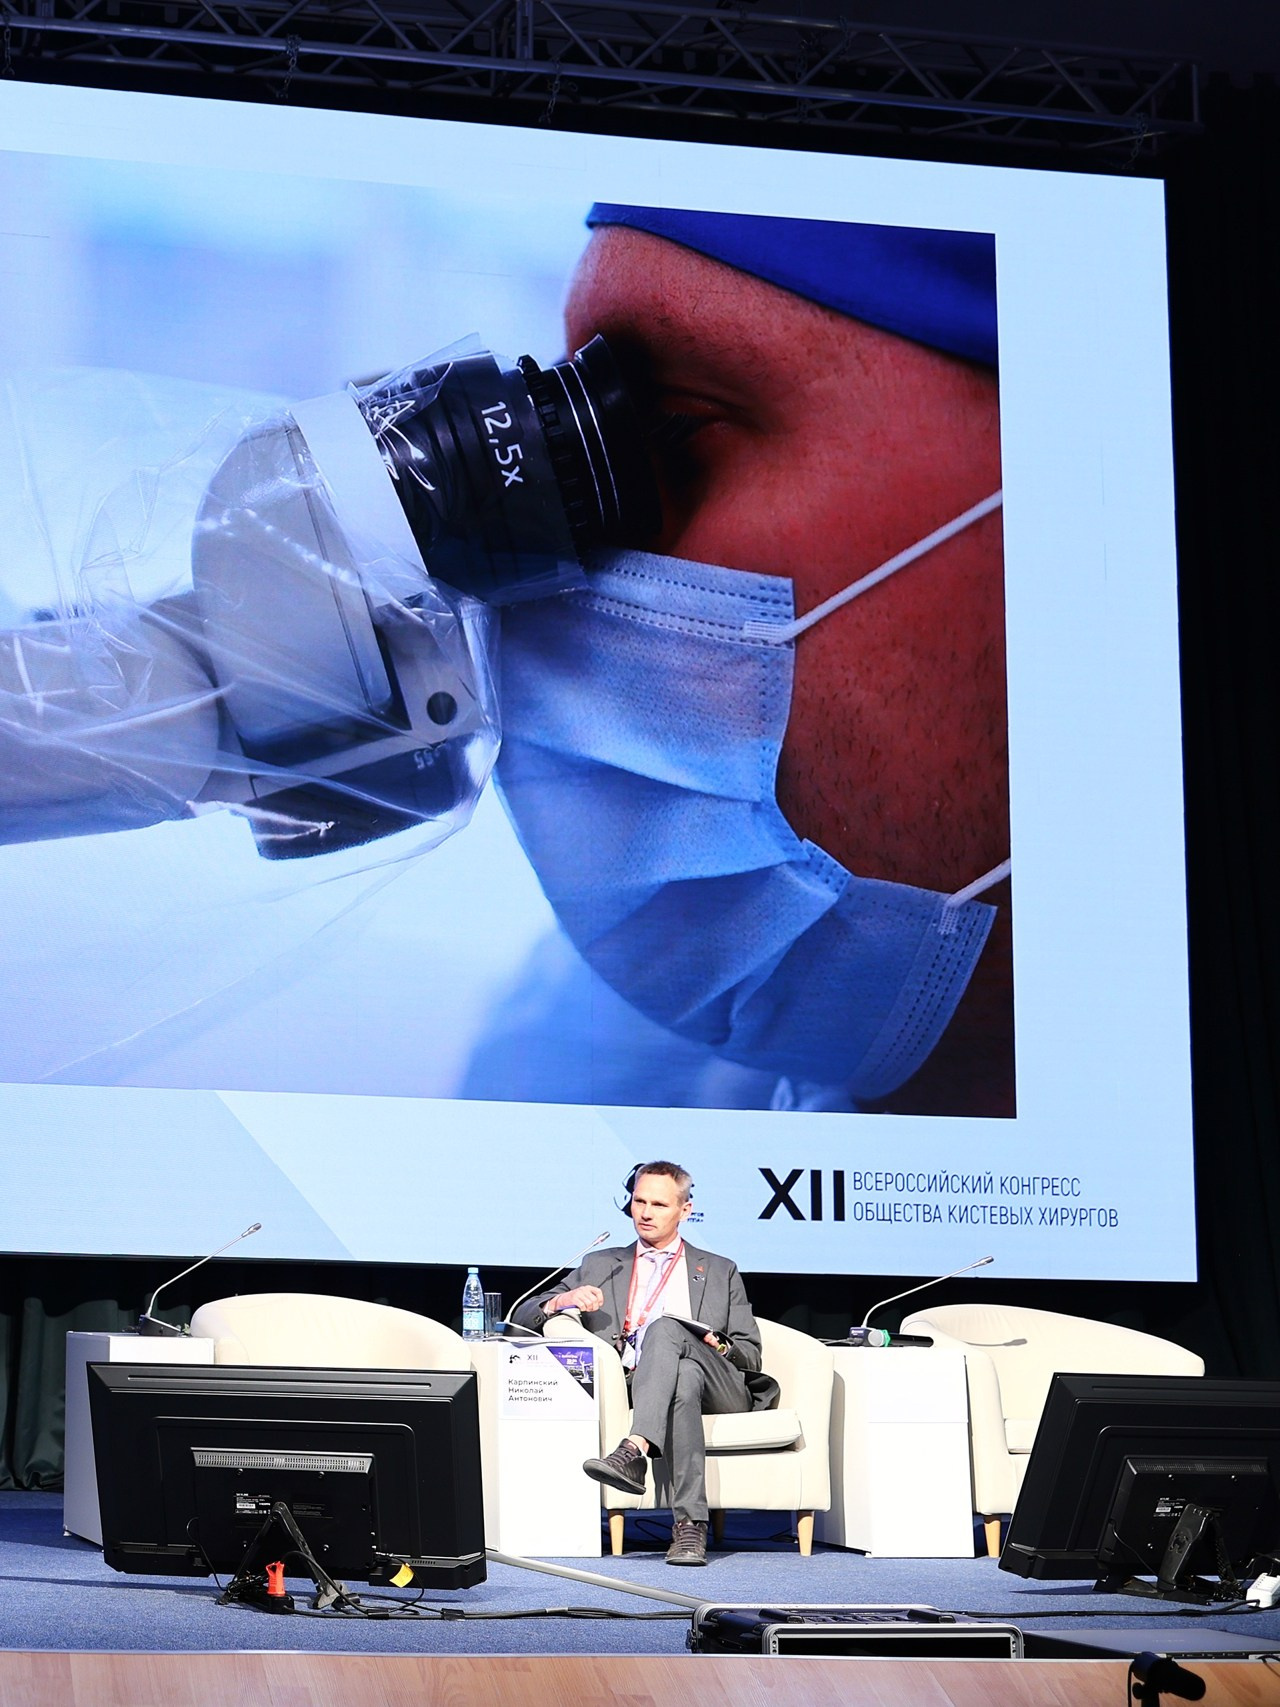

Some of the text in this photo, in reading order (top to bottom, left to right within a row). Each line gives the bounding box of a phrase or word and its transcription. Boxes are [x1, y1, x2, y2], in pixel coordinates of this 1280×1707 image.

[481, 400, 524, 488] 12,5x
[757, 1168, 846, 1222] XII
[853, 1169, 1081, 1197] ВСЕРОССИЙСКИЙ КОНГРЕСС
[853, 1201, 1119, 1228] ОБЩЕСТВА КИСТЕВЫХ ХИРУРГОВ
[508, 1378, 558, 1386] Карпинский
[508, 1386, 543, 1394] Николай
